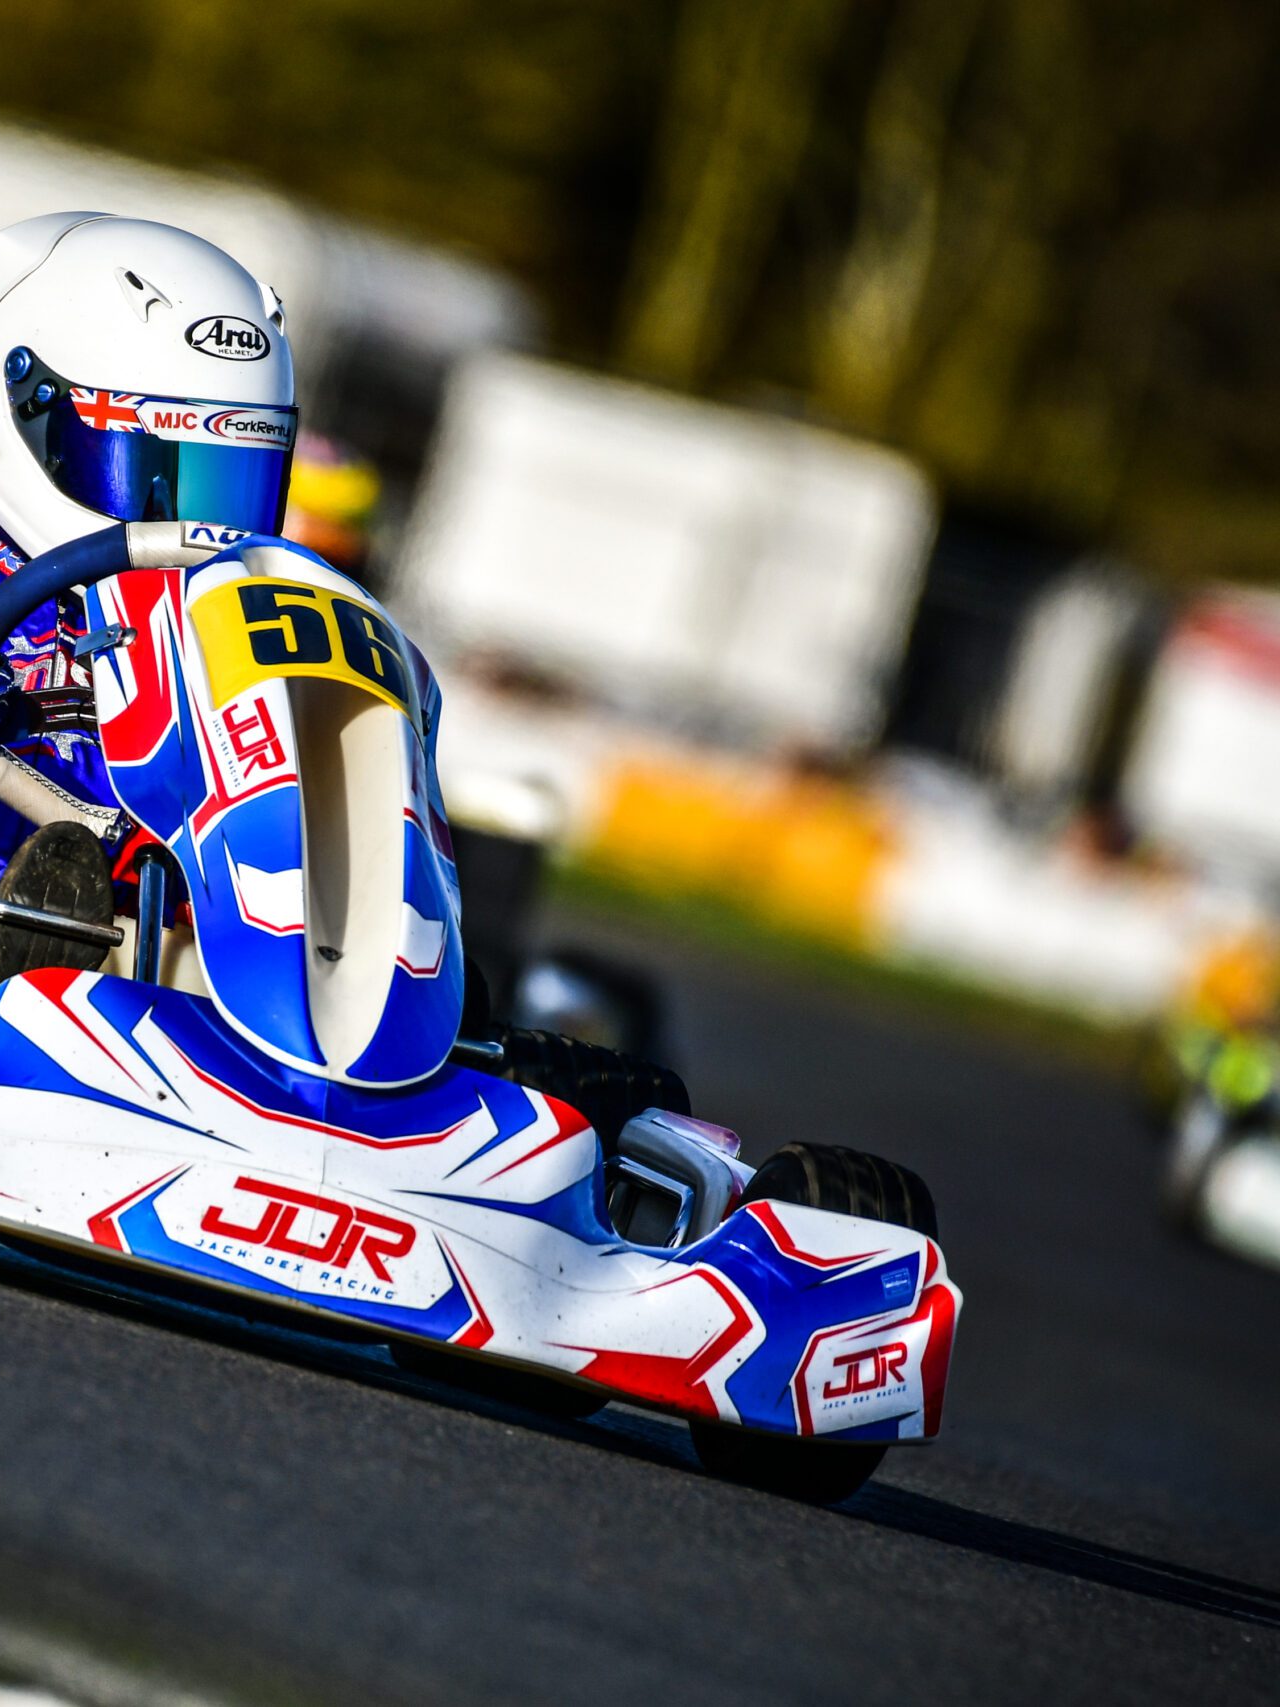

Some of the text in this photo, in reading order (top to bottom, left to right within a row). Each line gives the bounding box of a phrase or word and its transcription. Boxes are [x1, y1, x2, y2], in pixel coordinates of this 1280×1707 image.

[193, 319, 263, 350] Arai
[153, 411, 198, 430] MJC
[236, 584, 411, 706] 56
[222, 696, 287, 780] JDR
[200, 1175, 417, 1284] JDR
[195, 1239, 395, 1300] JACK DEX RACING
[823, 1341, 908, 1400] JDR
